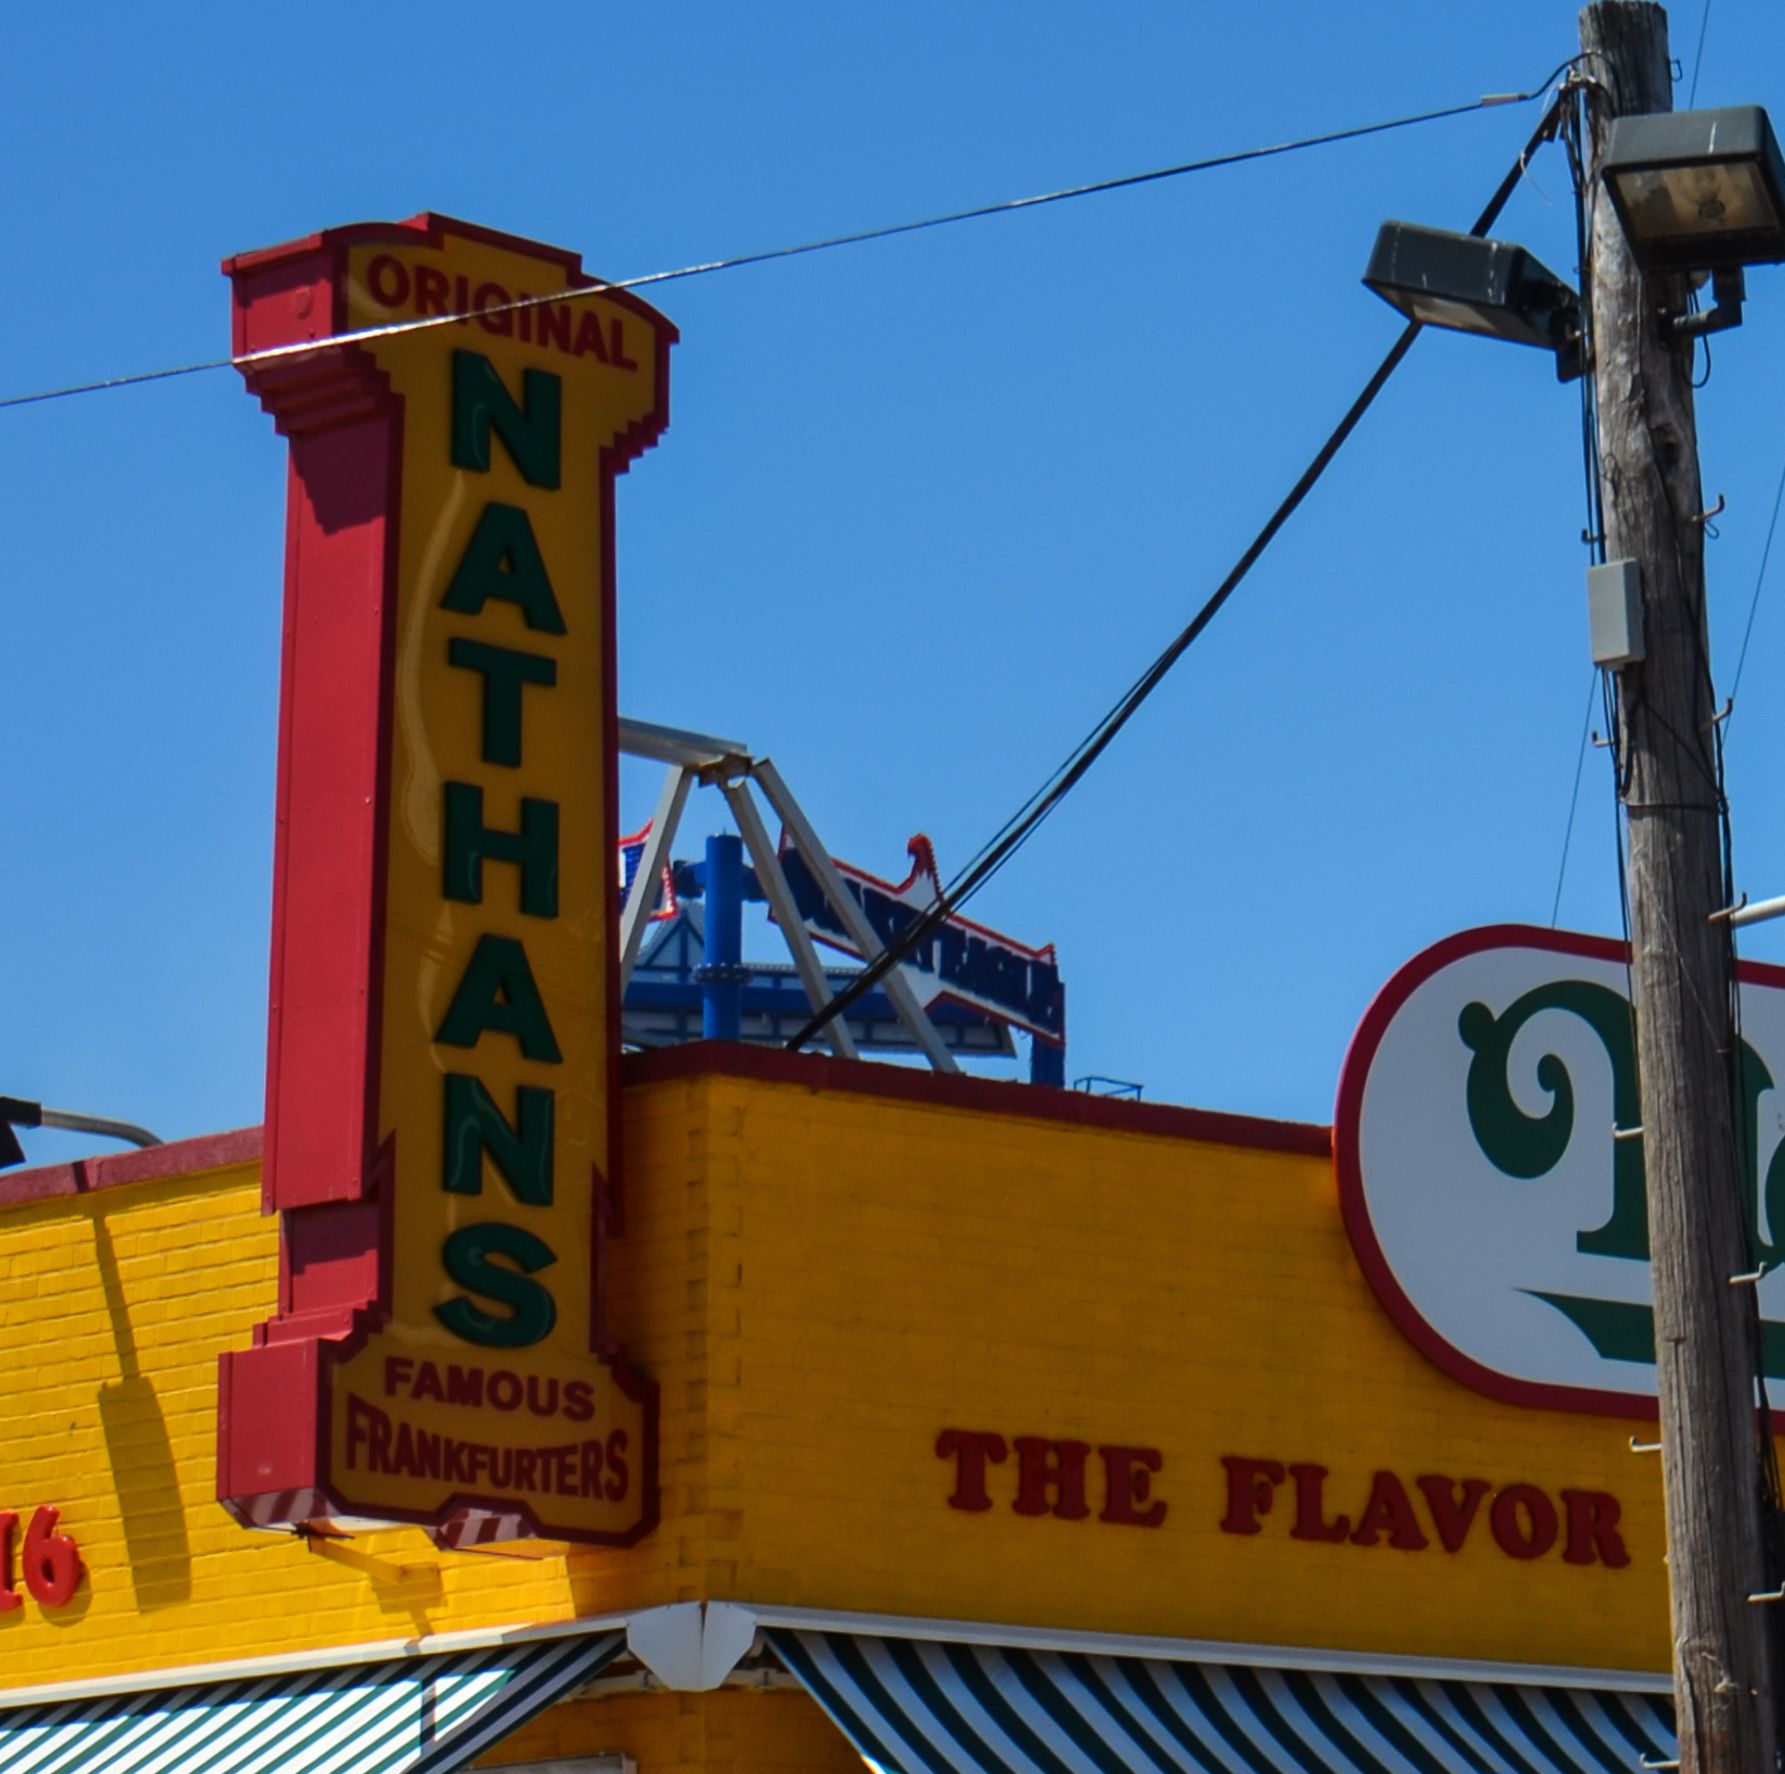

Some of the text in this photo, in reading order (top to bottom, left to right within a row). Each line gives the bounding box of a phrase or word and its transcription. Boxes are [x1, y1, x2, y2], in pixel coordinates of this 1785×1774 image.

[367, 253, 638, 373] ORIGINAL
[431, 348, 567, 1349] NATHANS
[345, 1391, 630, 1504] FRANKFURTERS
[384, 1356, 596, 1423] FAMOUS
[935, 1427, 1170, 1529] THE
[1220, 1454, 1633, 1570] FLAVOR
